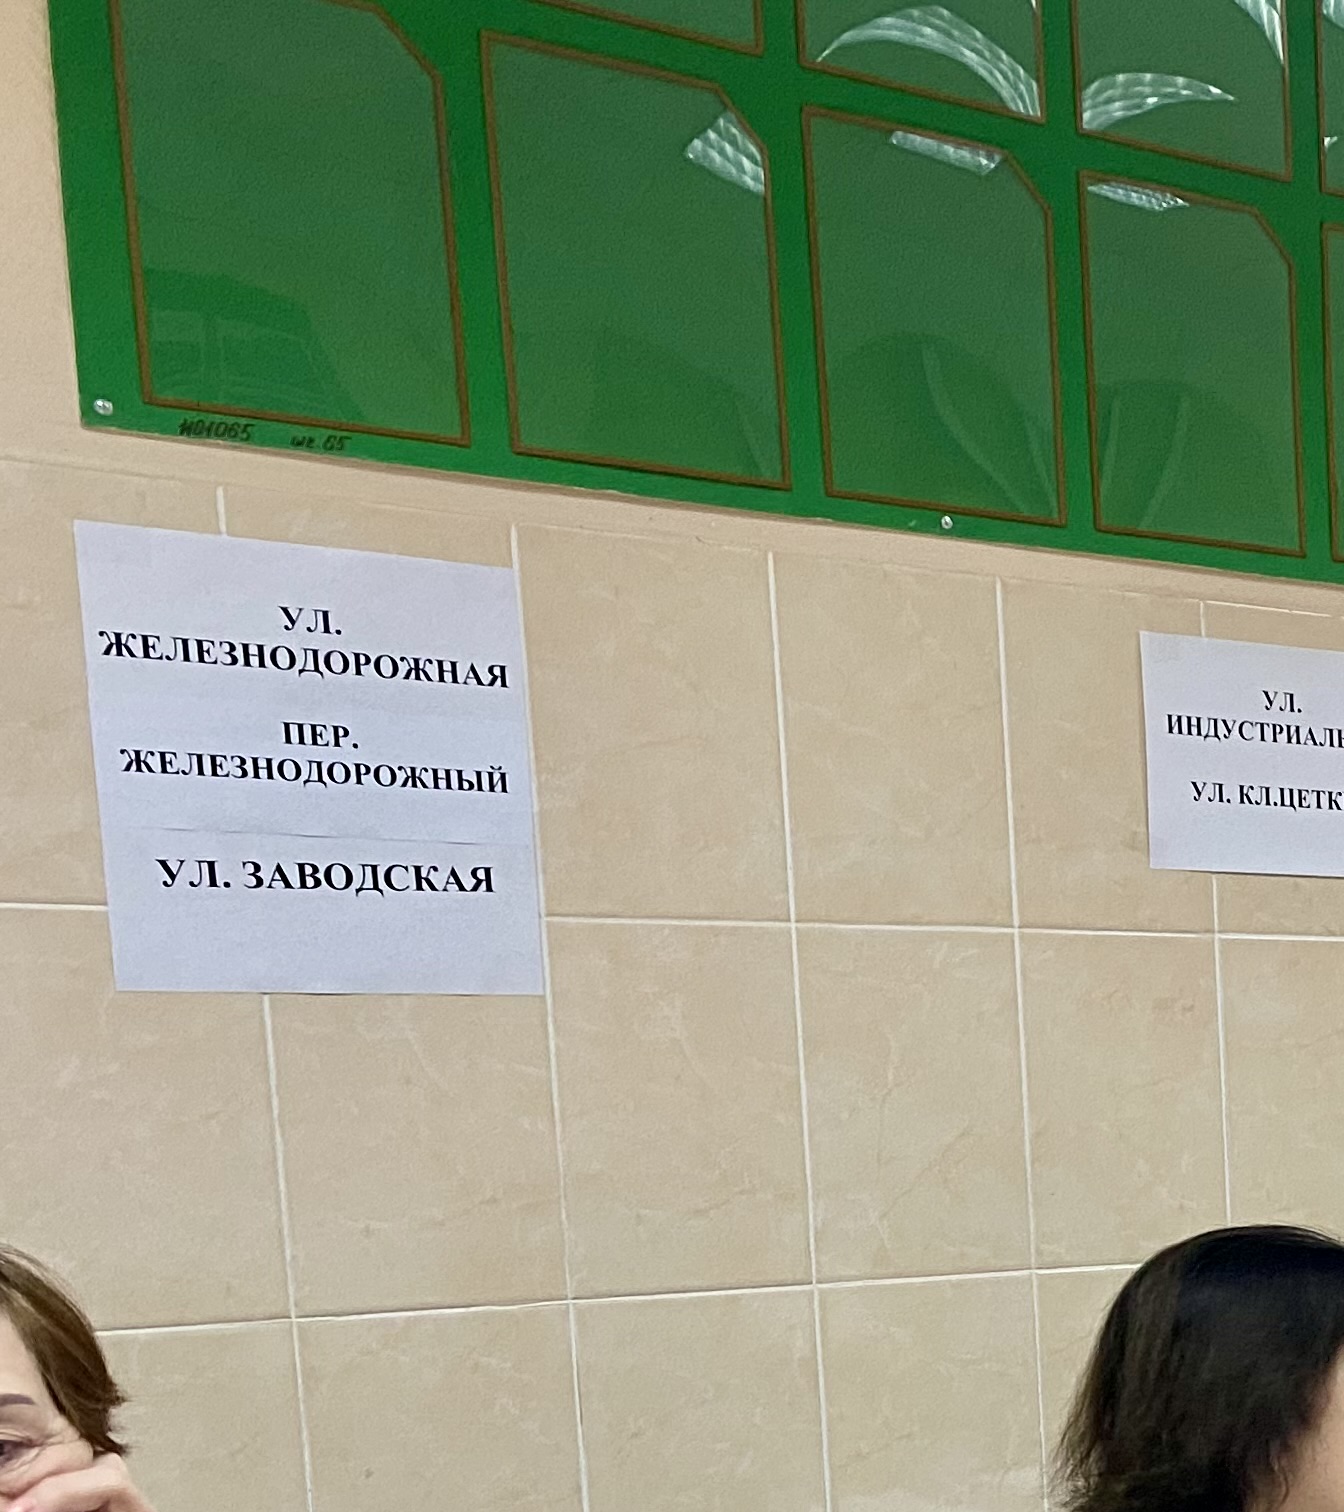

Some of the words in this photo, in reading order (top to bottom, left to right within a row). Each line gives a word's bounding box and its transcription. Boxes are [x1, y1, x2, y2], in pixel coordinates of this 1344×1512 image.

[279, 606, 342, 636] УЛ.
[99, 630, 509, 688] ЖЕЛЕЗНОДОРОЖНАЯ
[1262, 690, 1303, 713] УЛ.
[282, 721, 359, 749] ПЕР.
[119, 748, 509, 794] ЖЕЛЕЗНОДОРОЖНЫЙ
[1191, 781, 1232, 804] УЛ.
[155, 858, 231, 889] УЛ.
[242, 860, 494, 897] ЗАВОДСКАЯ
